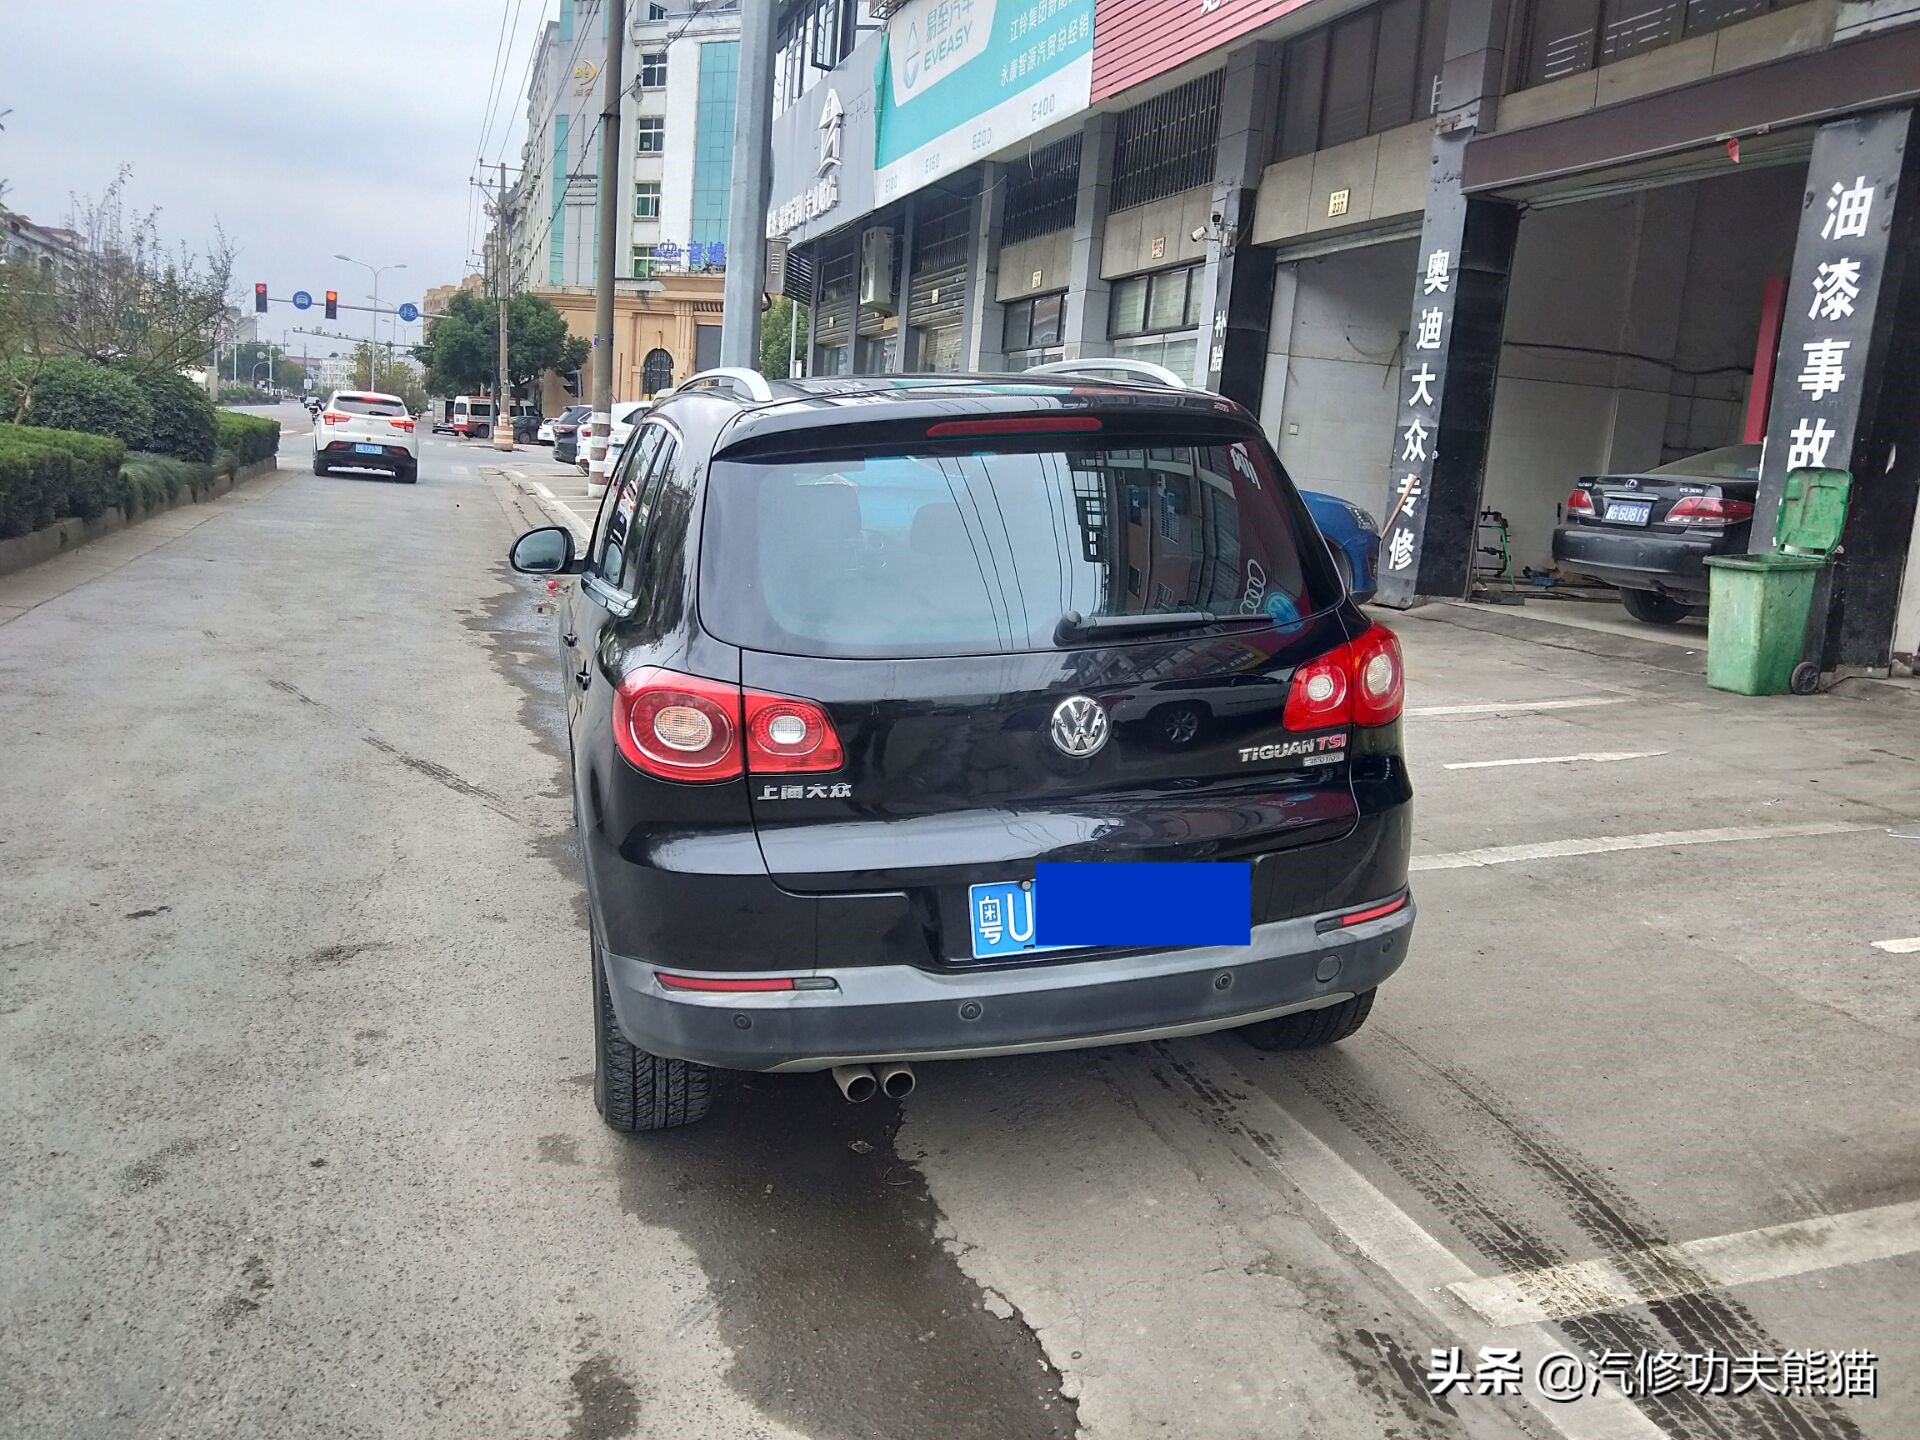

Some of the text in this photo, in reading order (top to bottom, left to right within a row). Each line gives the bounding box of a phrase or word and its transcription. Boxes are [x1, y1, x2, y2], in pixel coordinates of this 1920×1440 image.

[1009, 0, 1074, 42] 江铃集团新
[924, 21, 973, 72] EVEASY
[1000, 10, 1090, 87] 永康智源汽贸总经销
[1031, 93, 1056, 122] E400
[971, 127, 992, 151] E200
[1210, 310, 1227, 372] 补胎
[1787, 176, 1875, 473] 油漆事故
[1388, 249, 1450, 571] 奥迪大众专修
[1316, 733, 1347, 751] TSI
[757, 782, 852, 800] 上海大众
